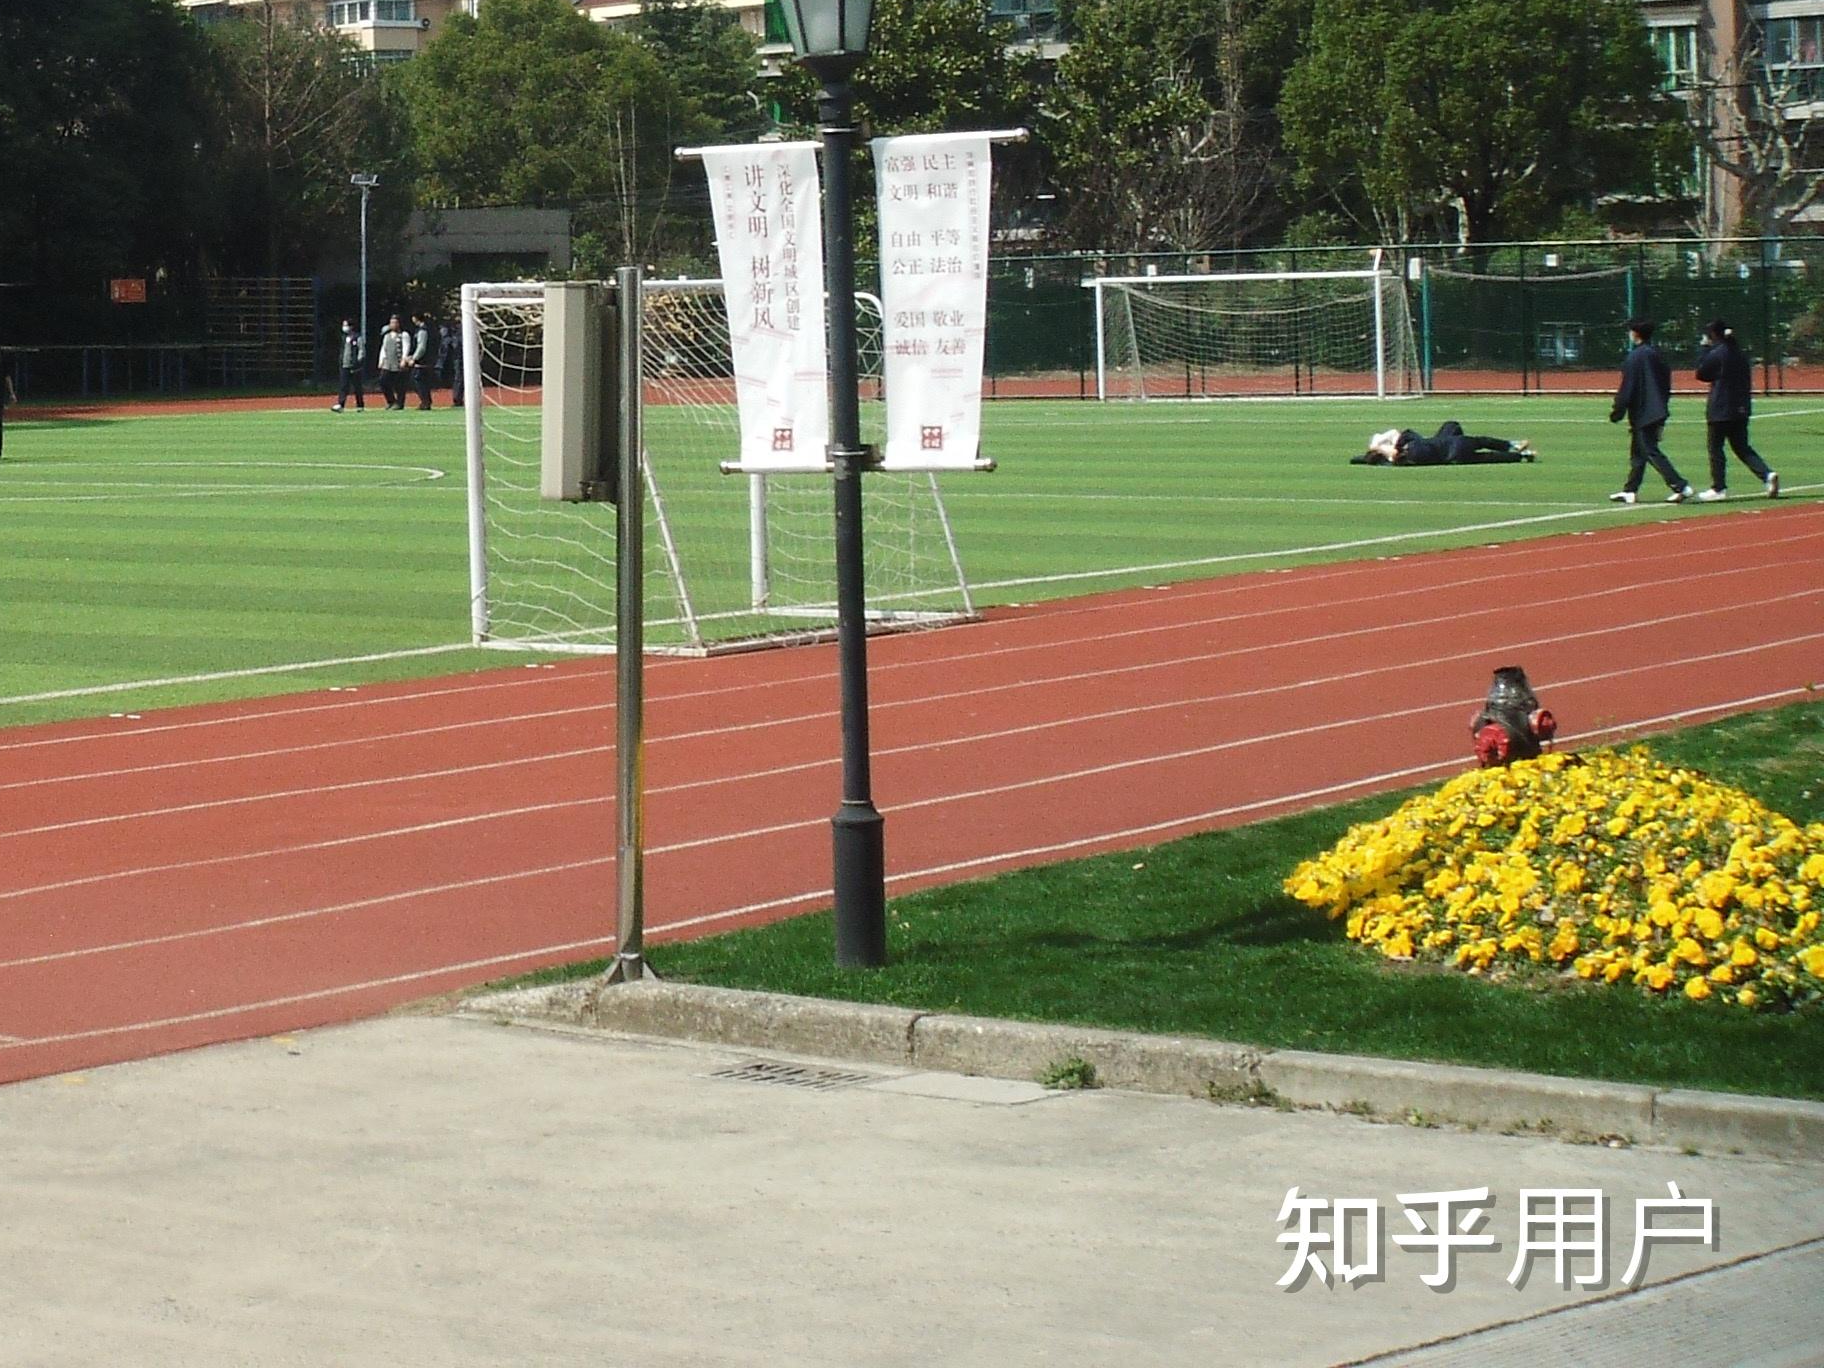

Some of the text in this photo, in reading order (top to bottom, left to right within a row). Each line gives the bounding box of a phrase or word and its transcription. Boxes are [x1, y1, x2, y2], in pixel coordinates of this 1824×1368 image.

[886, 154, 956, 172] 富强 民主
[889, 183, 958, 201] 文明 和谐
[745, 165, 774, 329] 讲文明 树新风
[891, 229, 961, 248] 自由 平等
[892, 258, 962, 275] 公正 法治
[894, 311, 964, 328] 爱国 敬业
[895, 339, 966, 356] 诚信 友善
